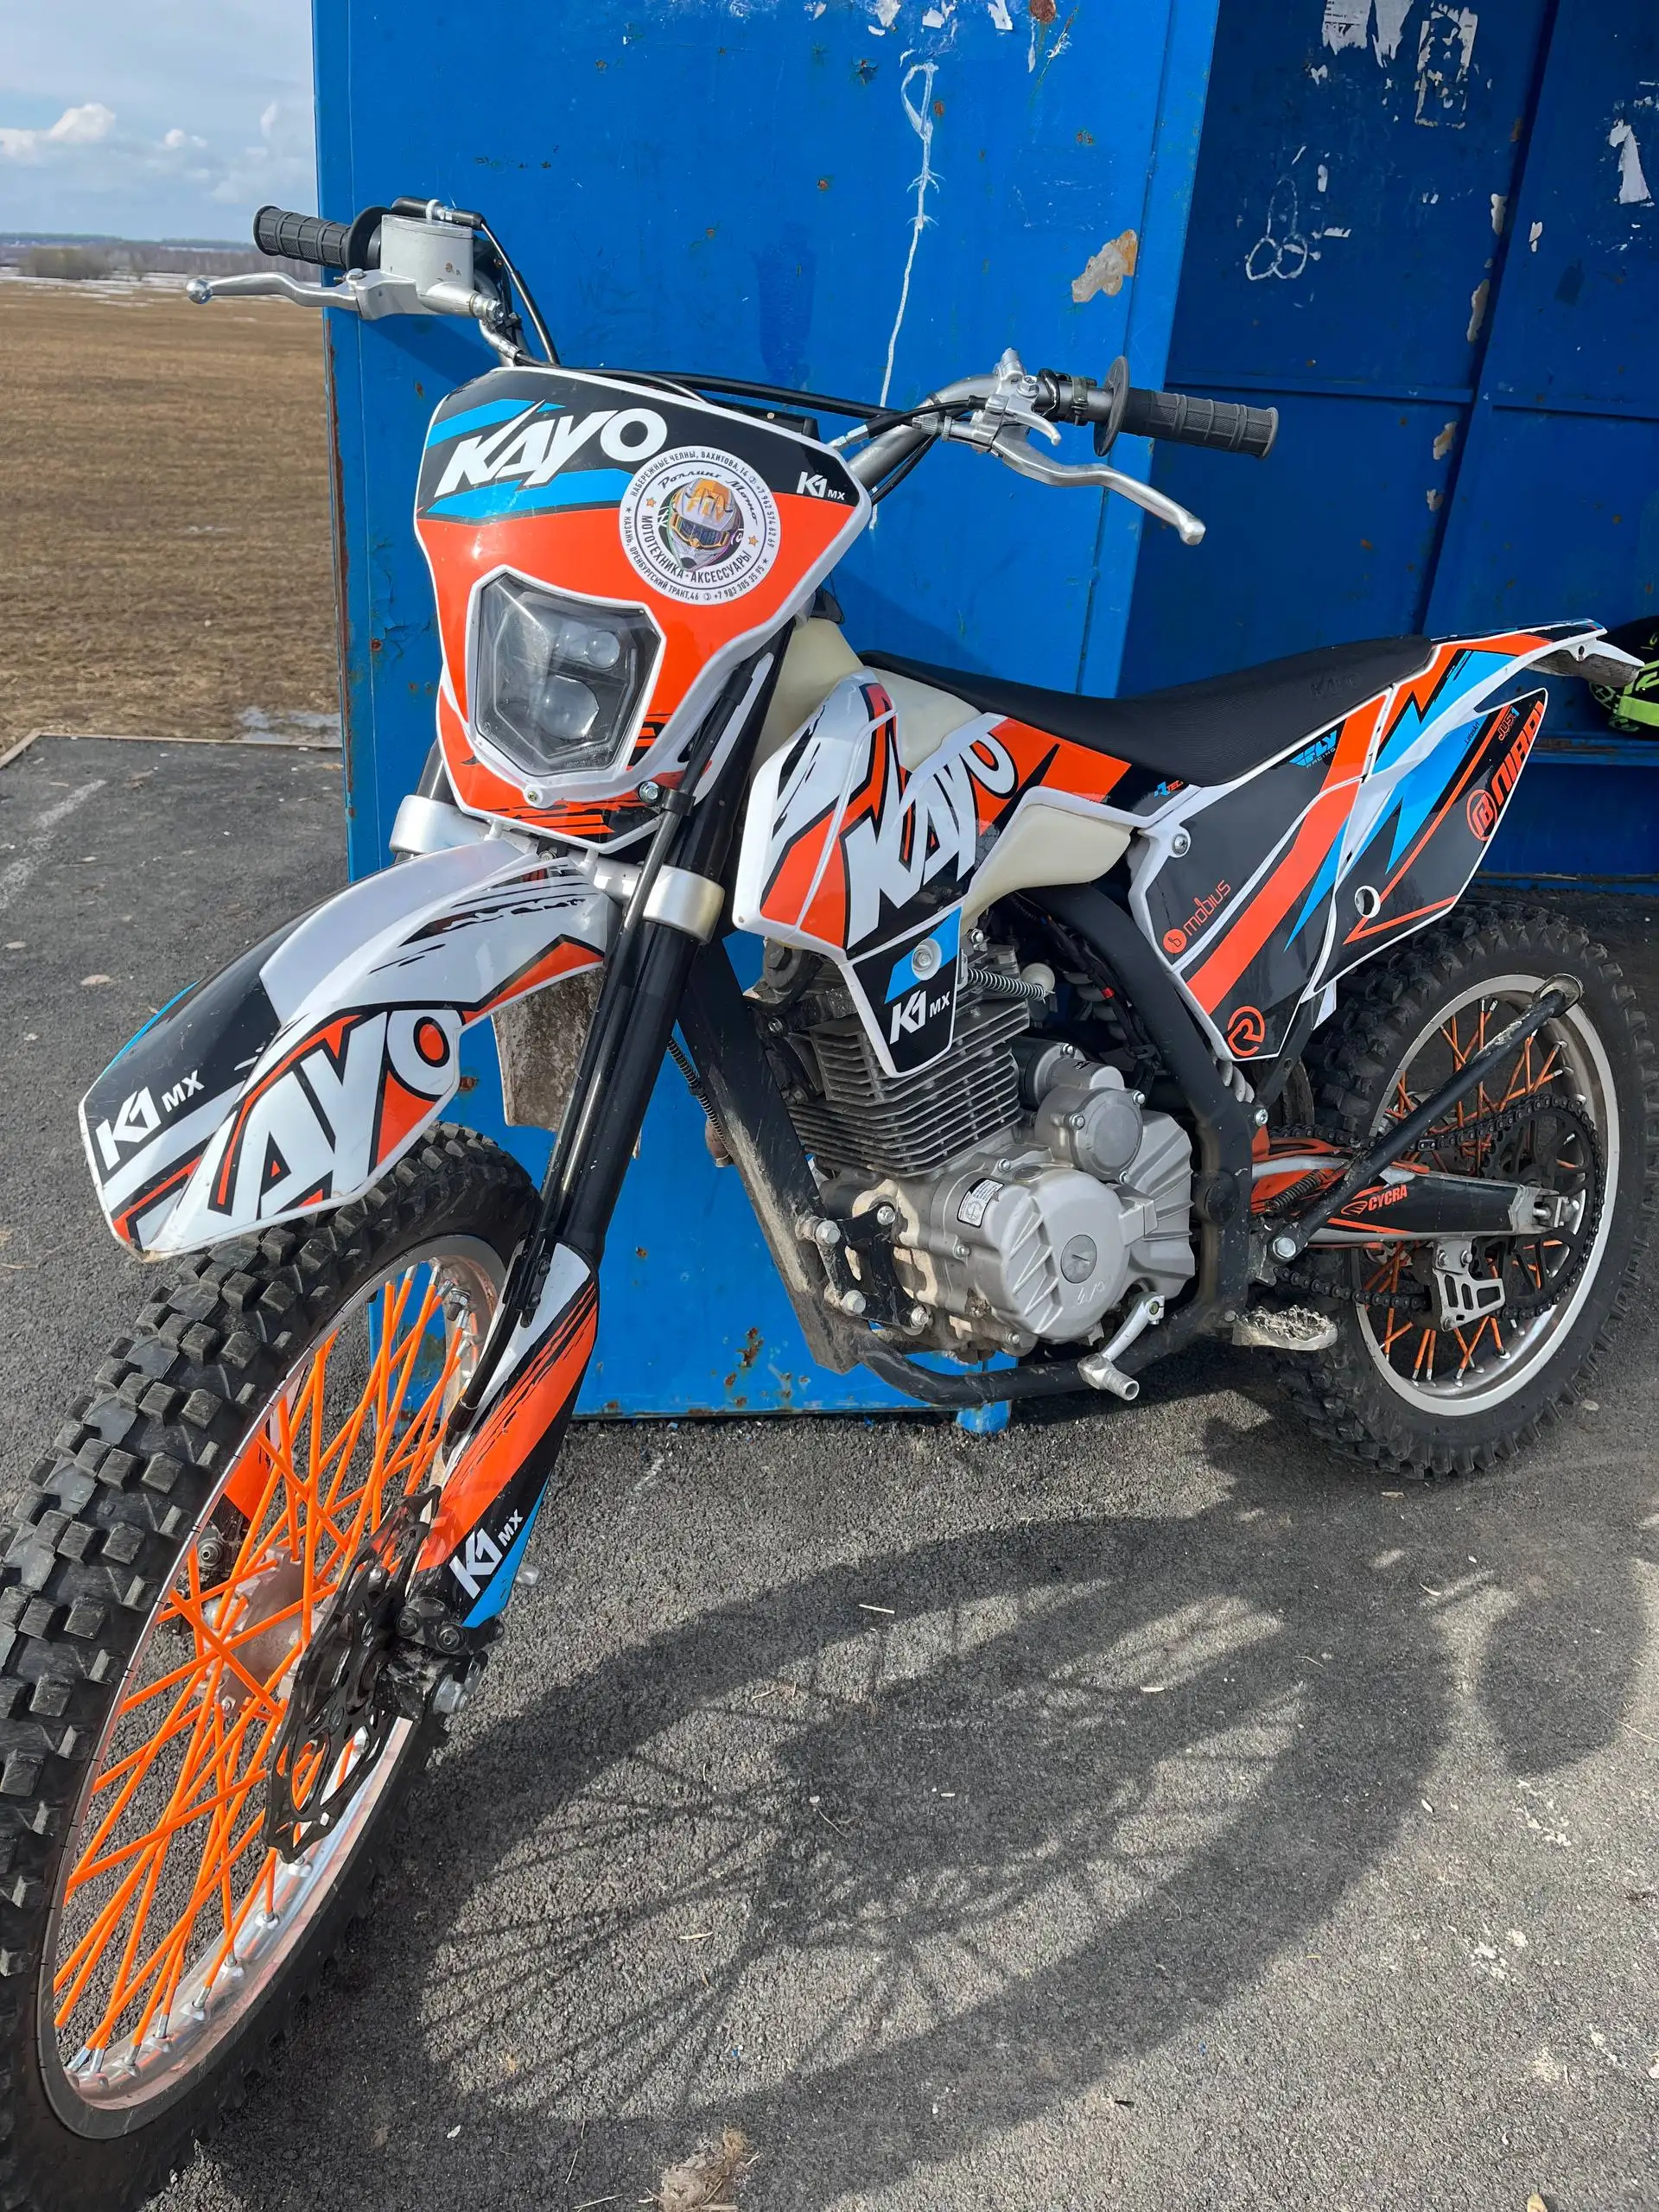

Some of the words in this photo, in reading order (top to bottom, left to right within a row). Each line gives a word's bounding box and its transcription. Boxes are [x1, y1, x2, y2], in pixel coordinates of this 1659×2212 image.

[435, 398, 667, 498] KAYO
[669, 450, 699, 462] ЧЕЛНЫ,
[630, 457, 670, 497] НАБЕРЕЖНЫЕ
[797, 471, 828, 499] K1
[827, 489, 846, 501] MX
[725, 480, 758, 525] Мото
[761, 495, 772, 509] 962
[766, 512, 776, 524] 574
[624, 516, 634, 546] КАЗАНЬ,
[629, 546, 669, 589] ОРЕНБУРГСКИЙ
[724, 587, 737, 597] 903
[737, 579, 750, 592] 305
[748, 572, 758, 582] 35
[755, 565, 765, 575] 95
[641, 515, 684, 579] МОТОТЕХНИКА
[690, 550, 752, 583] АКСЕССУАРЫ
[1294, 729, 1337, 766] FLY
[846, 728, 1015, 949] KAYO
[890, 989, 926, 1045] K1
[929, 990, 950, 1018] MX
[95, 1086, 162, 1171] K1
[162, 1070, 206, 1113] MX
[1368, 1184, 1408, 1211] CYCRA
[448, 1529, 503, 1599] K1
[498, 1509, 524, 1547] MX
